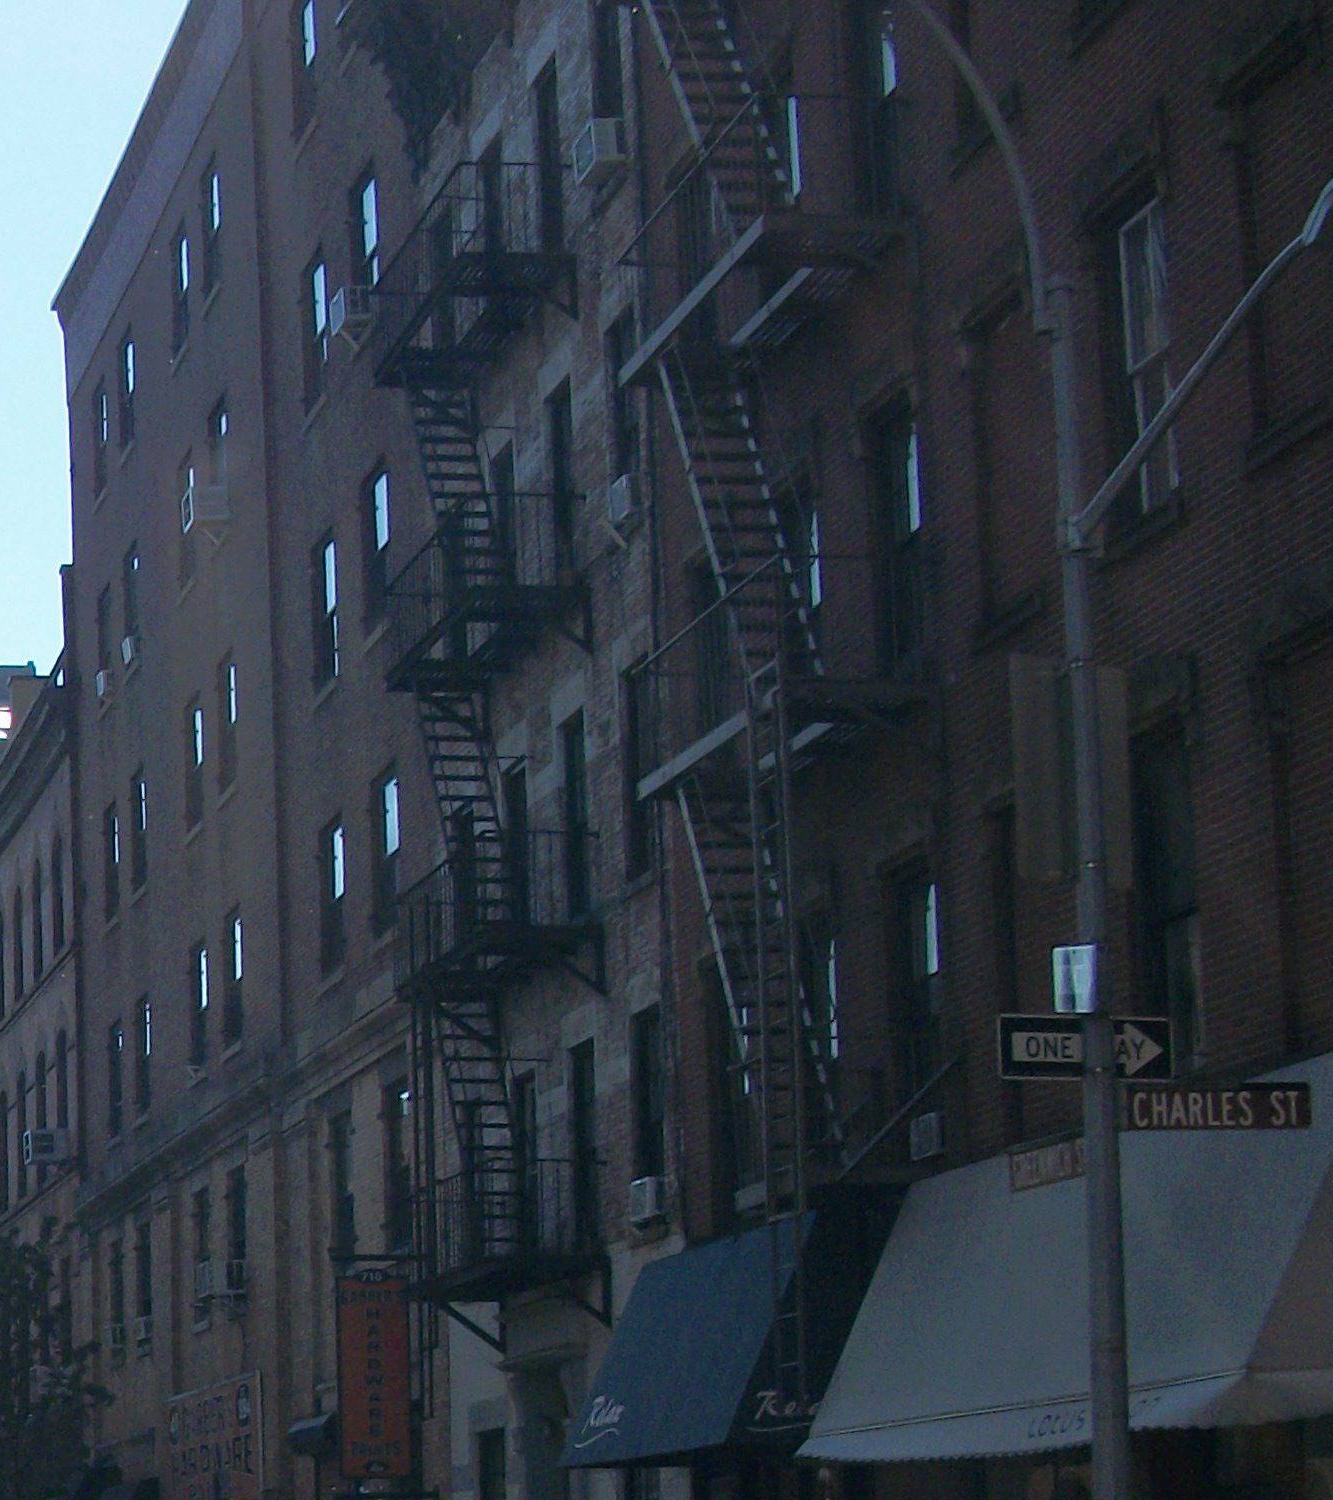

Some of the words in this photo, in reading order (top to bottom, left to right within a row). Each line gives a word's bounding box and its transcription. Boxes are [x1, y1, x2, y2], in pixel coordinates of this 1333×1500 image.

[1025, 1036, 1074, 1058] ONE
[1134, 1091, 1253, 1127] CHARLES
[1270, 1091, 1300, 1126] ST
[364, 1308, 384, 1435] HARDWARE
